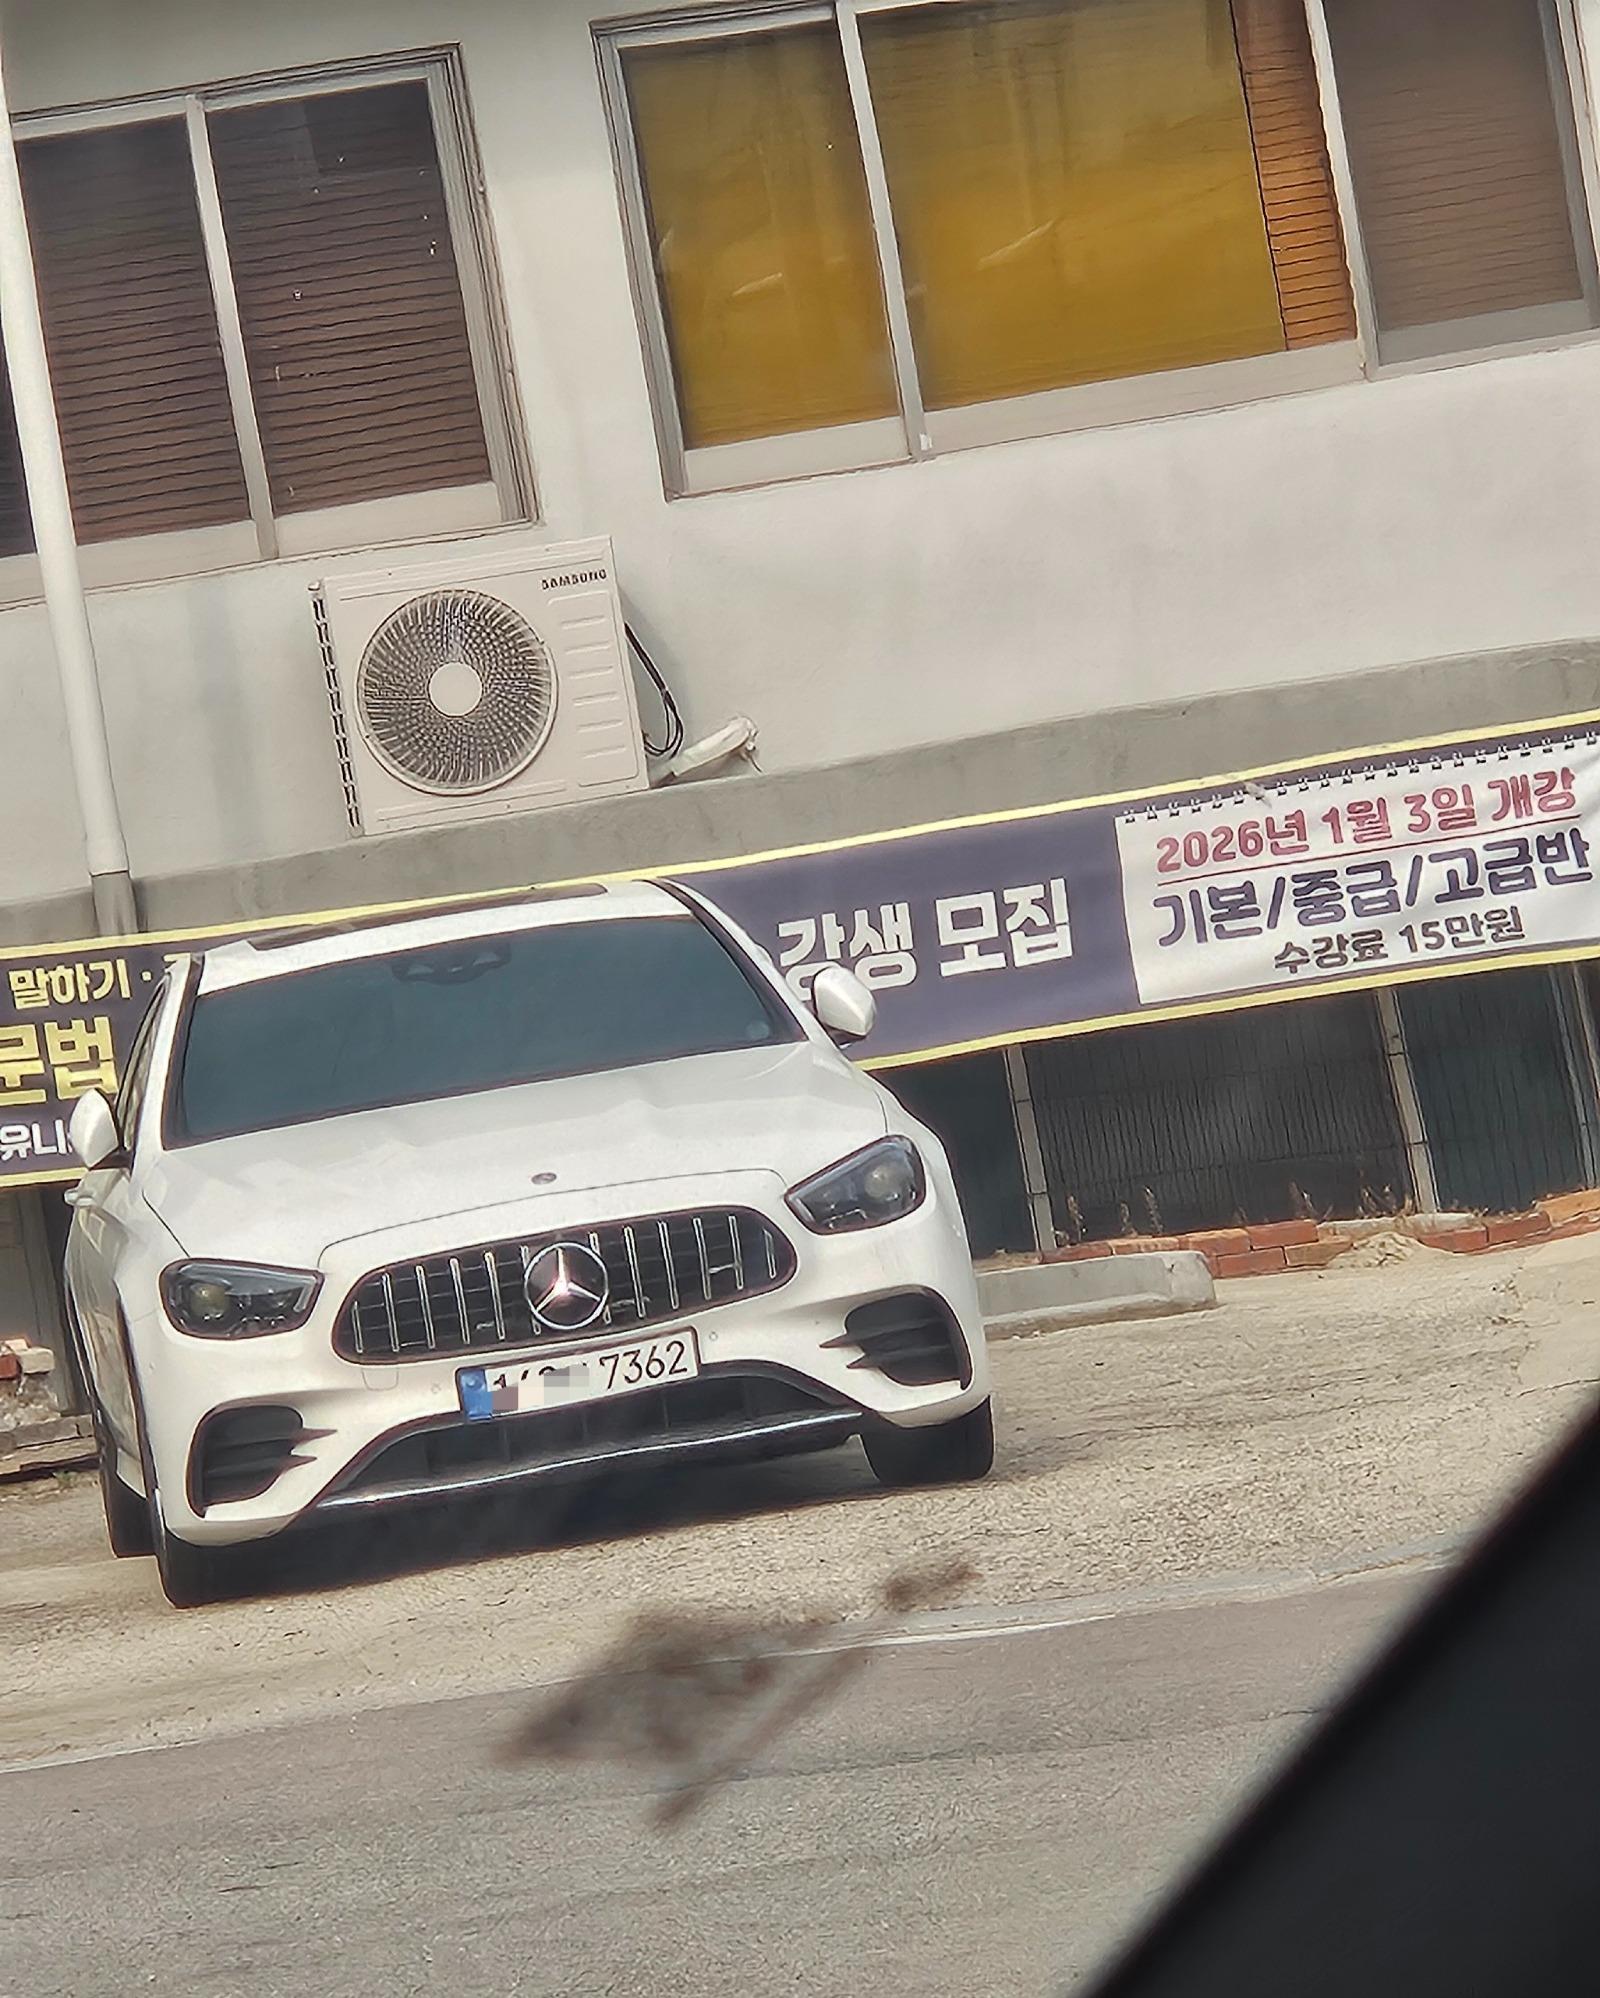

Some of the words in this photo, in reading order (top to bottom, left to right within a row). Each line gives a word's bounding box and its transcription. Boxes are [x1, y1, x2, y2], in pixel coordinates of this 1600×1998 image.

[541, 569, 607, 590] SAMSUNG
[1156, 809, 1310, 873] 2026년
[1321, 797, 1393, 845] 1월
[1403, 783, 1478, 834] 3일
[1487, 766, 1577, 823] 개강
[1153, 826, 1594, 948] 기본/중급/고급반
[934, 876, 1076, 978] 모집
[1273, 928, 1389, 974] 수강료
[1399, 905, 1526, 953] 15만원
[8, 958, 132, 1010] 말하기
[0, 1119, 73, 1161] 유니
[600, 1340, 689, 1390] 7362
